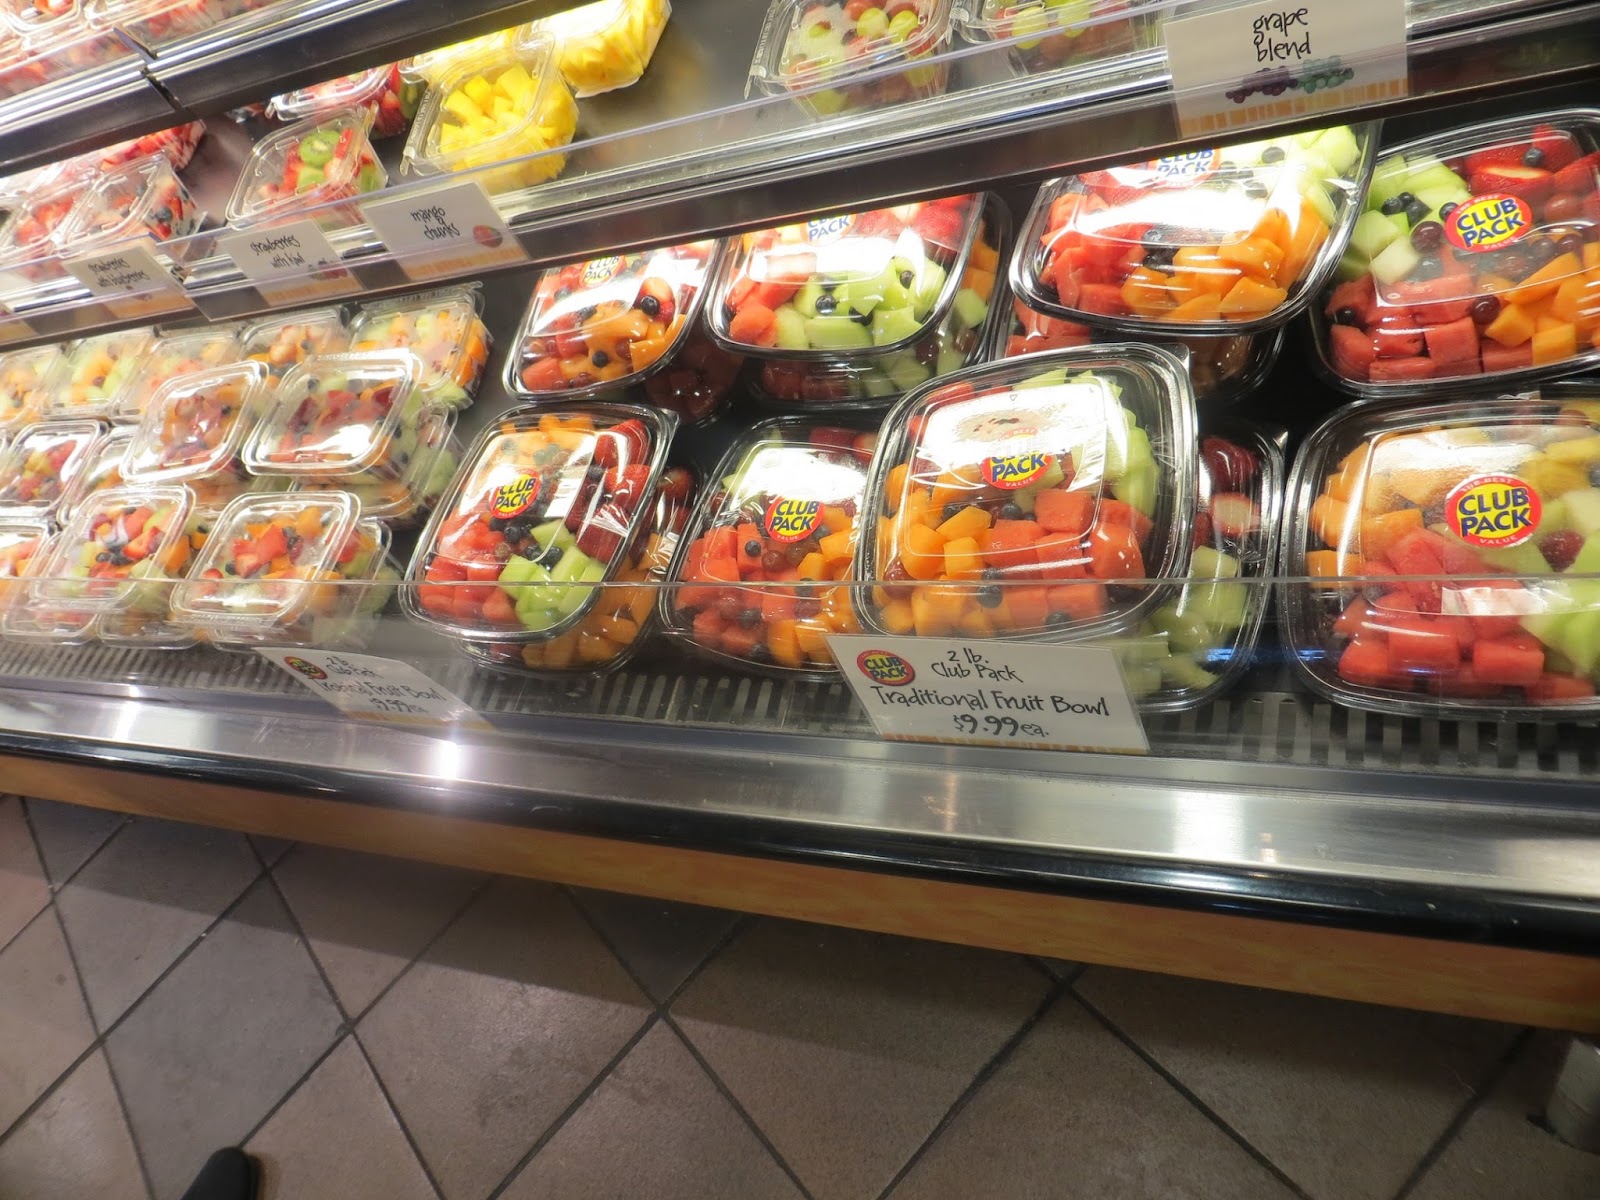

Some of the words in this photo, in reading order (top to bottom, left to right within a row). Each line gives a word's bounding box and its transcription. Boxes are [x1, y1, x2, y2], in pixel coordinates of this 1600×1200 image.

[1253, 7, 1308, 46] grape
[1256, 32, 1311, 62] blend
[1157, 160, 1211, 177] PACK
[410, 205, 446, 225] mango
[1456, 198, 1518, 230] CLUB
[423, 222, 460, 240] chunks
[808, 215, 850, 241] PACK
[1462, 212, 1525, 248] PACK
[249, 235, 301, 256] strawberries
[582, 265, 617, 283] PACK
[992, 453, 1046, 482] PACK
[499, 478, 537, 496] CLUB
[1005, 477, 1034, 487] VALUE
[1484, 476, 1514, 484] BEST
[492, 491, 532, 511] PACK
[775, 500, 821, 516] CLUB
[1458, 487, 1530, 516] CLUB
[769, 516, 816, 532] PACK
[1460, 507, 1533, 538] PACK
[1480, 535, 1518, 545] VALUE
[863, 656, 903, 670] CLUB
[947, 650, 961, 662] 2
[962, 647, 990, 665] lb.
[869, 666, 911, 680] PACK
[930, 661, 971, 679] Club
[974, 663, 1024, 683] Pack
[870, 685, 989, 711] Traditional
[990, 690, 1045, 711] Fruit
[1052, 694, 1110, 716] Bowl
